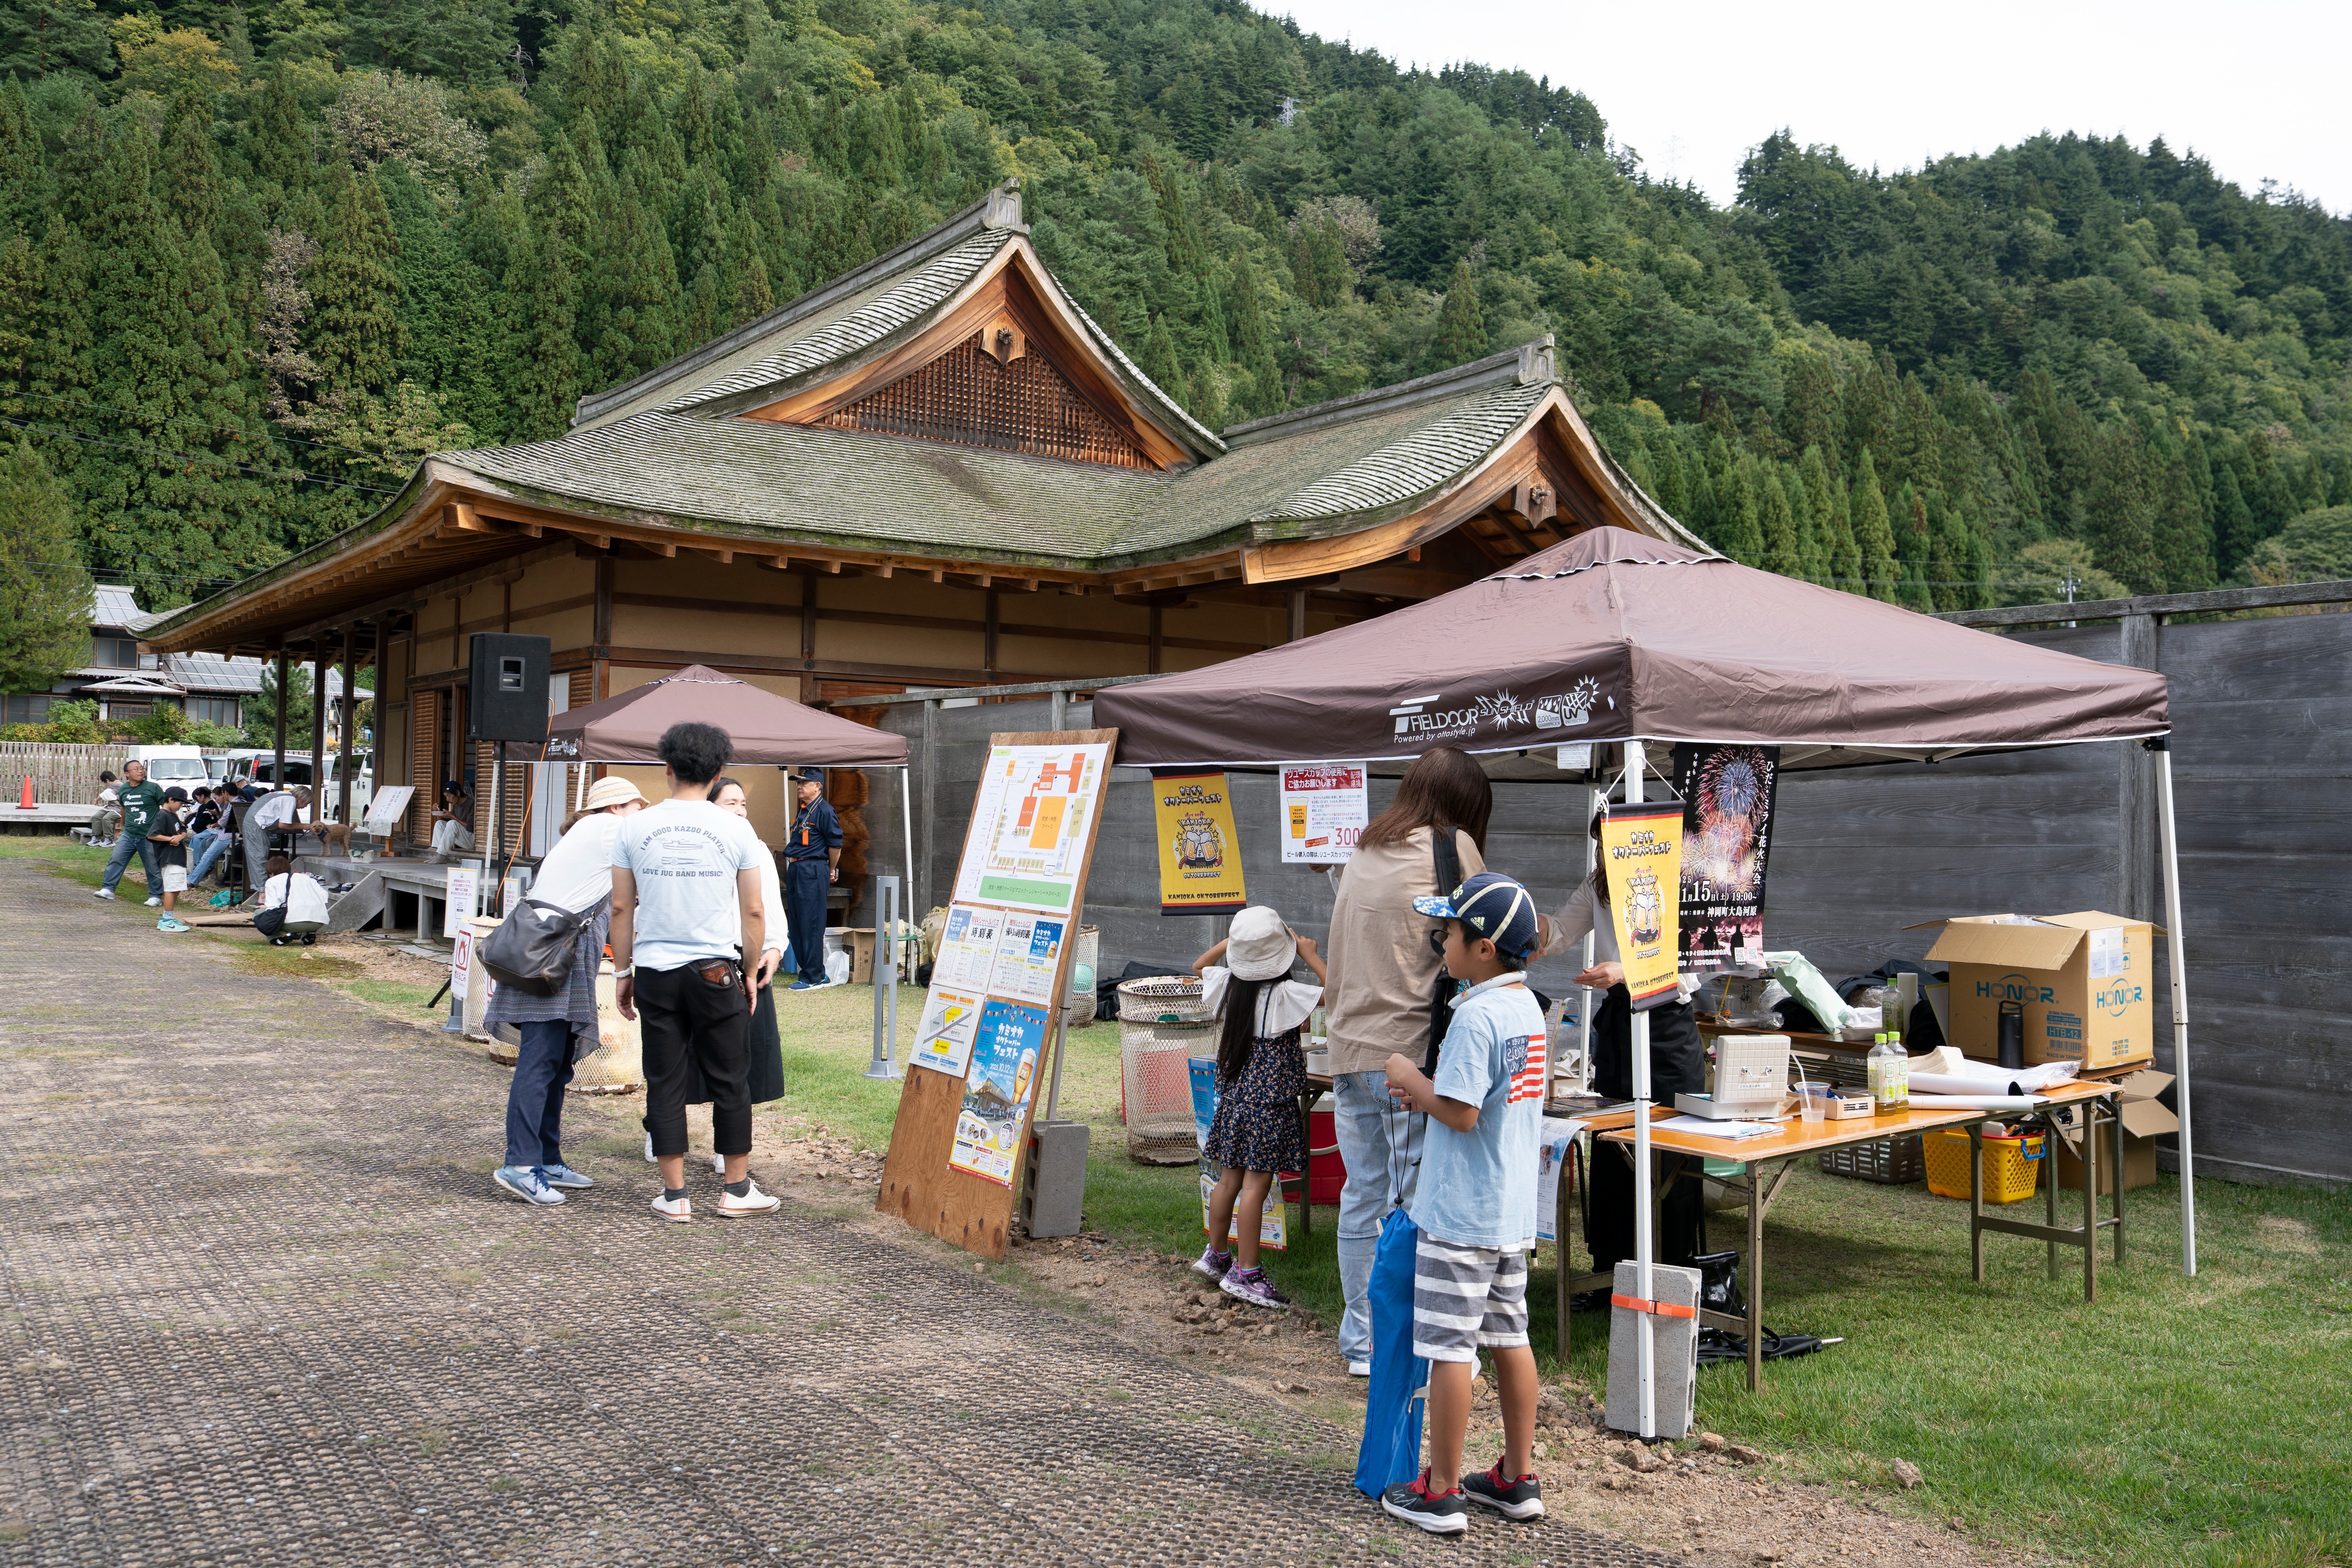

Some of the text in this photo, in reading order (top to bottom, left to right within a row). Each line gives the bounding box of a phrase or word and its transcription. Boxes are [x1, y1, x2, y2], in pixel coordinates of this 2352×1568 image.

[1410, 708, 1478, 731] FIELDOOR
[1564, 708, 1578, 719] UV
[1394, 726, 1475, 743] Powered by ottostyle.jp
[1287, 767, 1348, 779] リユースカップの使用に
[1351, 771, 1356, 787] 配慮
[1356, 771, 1361, 787] 環境
[1288, 779, 1337, 788] ご協力お願いします
[1179, 786, 1203, 796] カミオカ
[1163, 794, 1222, 806] オクトーバーフェスト
[1181, 818, 1212, 827] KAMIOKA
[643, 836, 653, 846] AM
[652, 827, 671, 837] GOOD
[702, 830, 725, 854] PLAYER
[1335, 828, 1361, 845] 300
[1630, 830, 1654, 845] カミオカ
[1612, 841, 1671, 860] オクトーバーフェスト
[1630, 875, 1656, 887] KAMIOKA
[1707, 906, 1757, 917] 神岡町大島河原
[971, 916, 1000, 926] 無料シャトルバス
[1470, 917, 1484, 931] adidas
[971, 927, 993, 939] 時刻表
[1005, 927, 1031, 939] 帰りの時刻表
[1637, 947, 1661, 959] OKTOBERFEST
[1630, 971, 1674, 989] KAMIOKA OKTOBERFEST
[1977, 981, 2054, 1003] HONOR
[2097, 987, 2142, 1008] HONOR
[998, 1023, 1024, 1039] カミオカ
[996, 1035, 1021, 1047] オクトーバー
[993, 1044, 1018, 1059] フェスト
